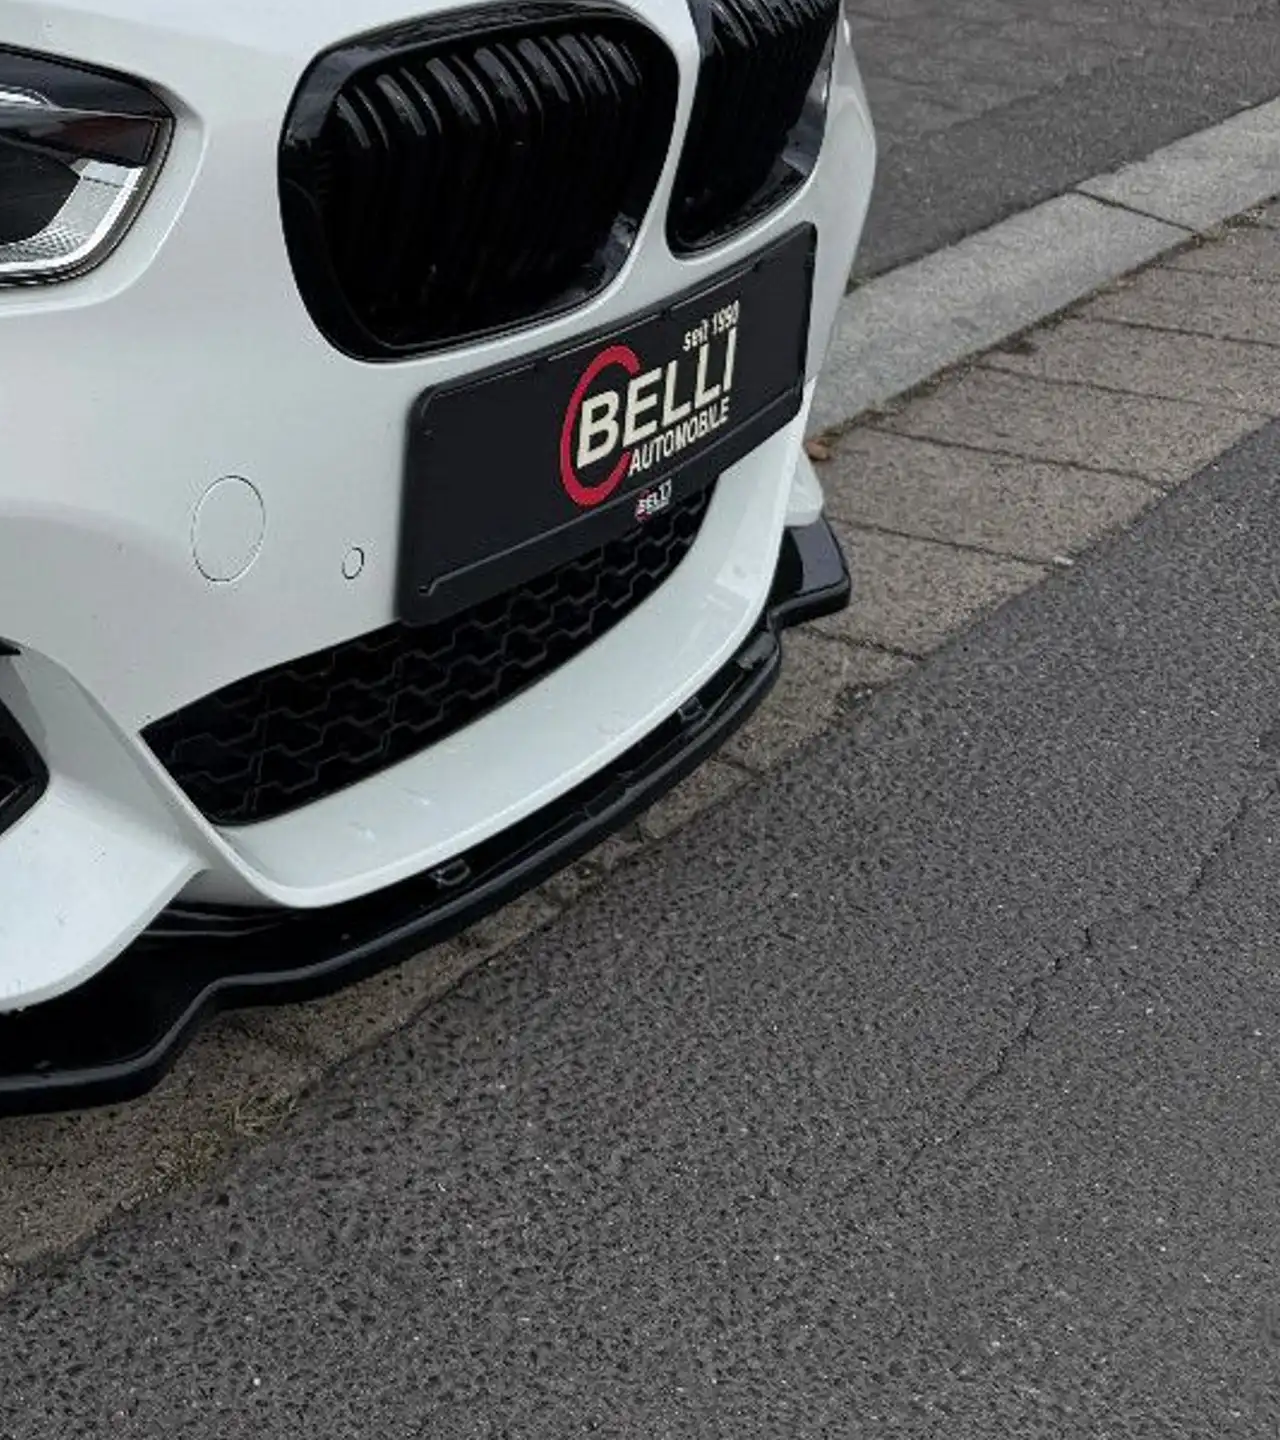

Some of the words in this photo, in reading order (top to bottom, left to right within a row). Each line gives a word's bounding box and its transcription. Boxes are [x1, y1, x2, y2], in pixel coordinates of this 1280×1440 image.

[682, 318, 709, 352] seit
[712, 300, 739, 336] 1990
[577, 326, 737, 470] BELLI
[628, 396, 731, 478] AUTOMOBILE
